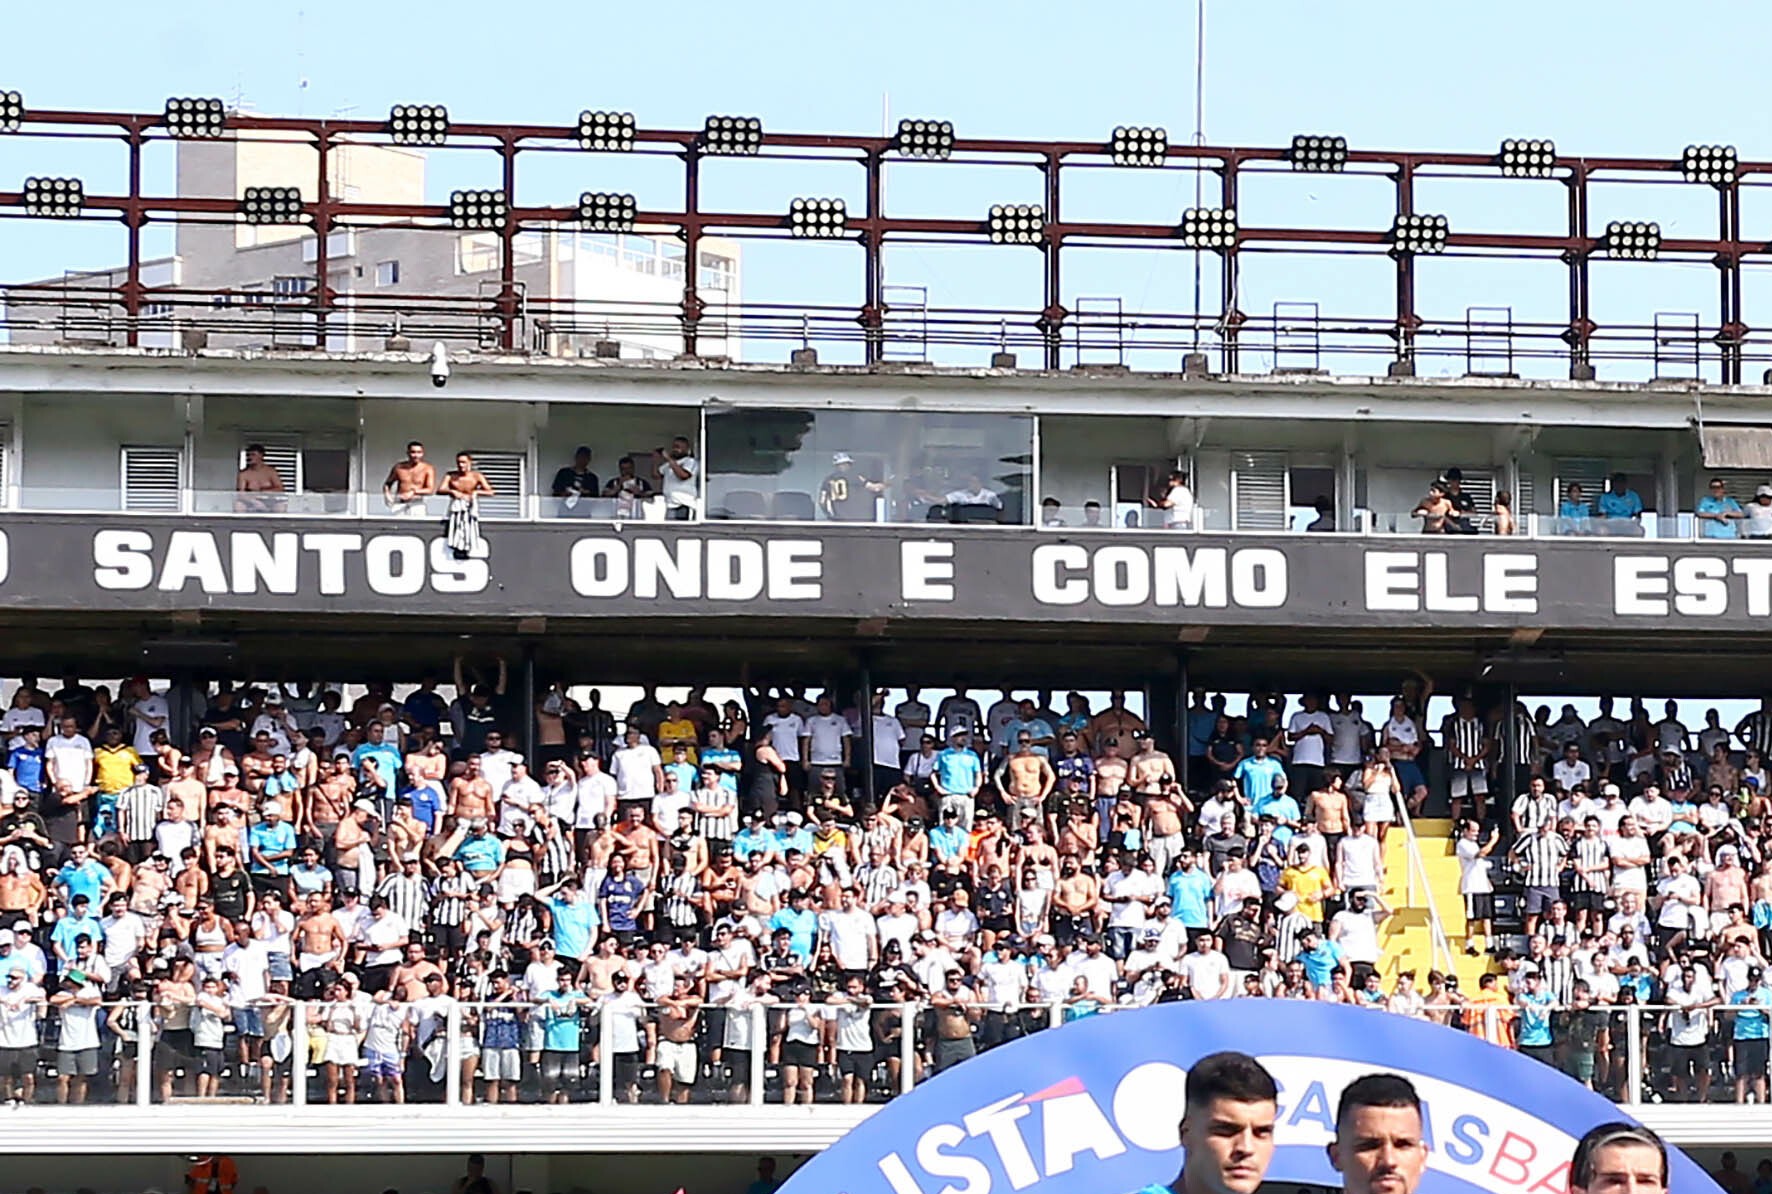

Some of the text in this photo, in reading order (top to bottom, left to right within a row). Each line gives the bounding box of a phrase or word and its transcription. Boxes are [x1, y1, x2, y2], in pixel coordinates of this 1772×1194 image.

[94, 529, 490, 596] SANTOS
[570, 537, 823, 601] ONDE
[900, 537, 955, 602] E
[1031, 544, 1288, 608] COMO
[1364, 550, 1539, 614] ELE
